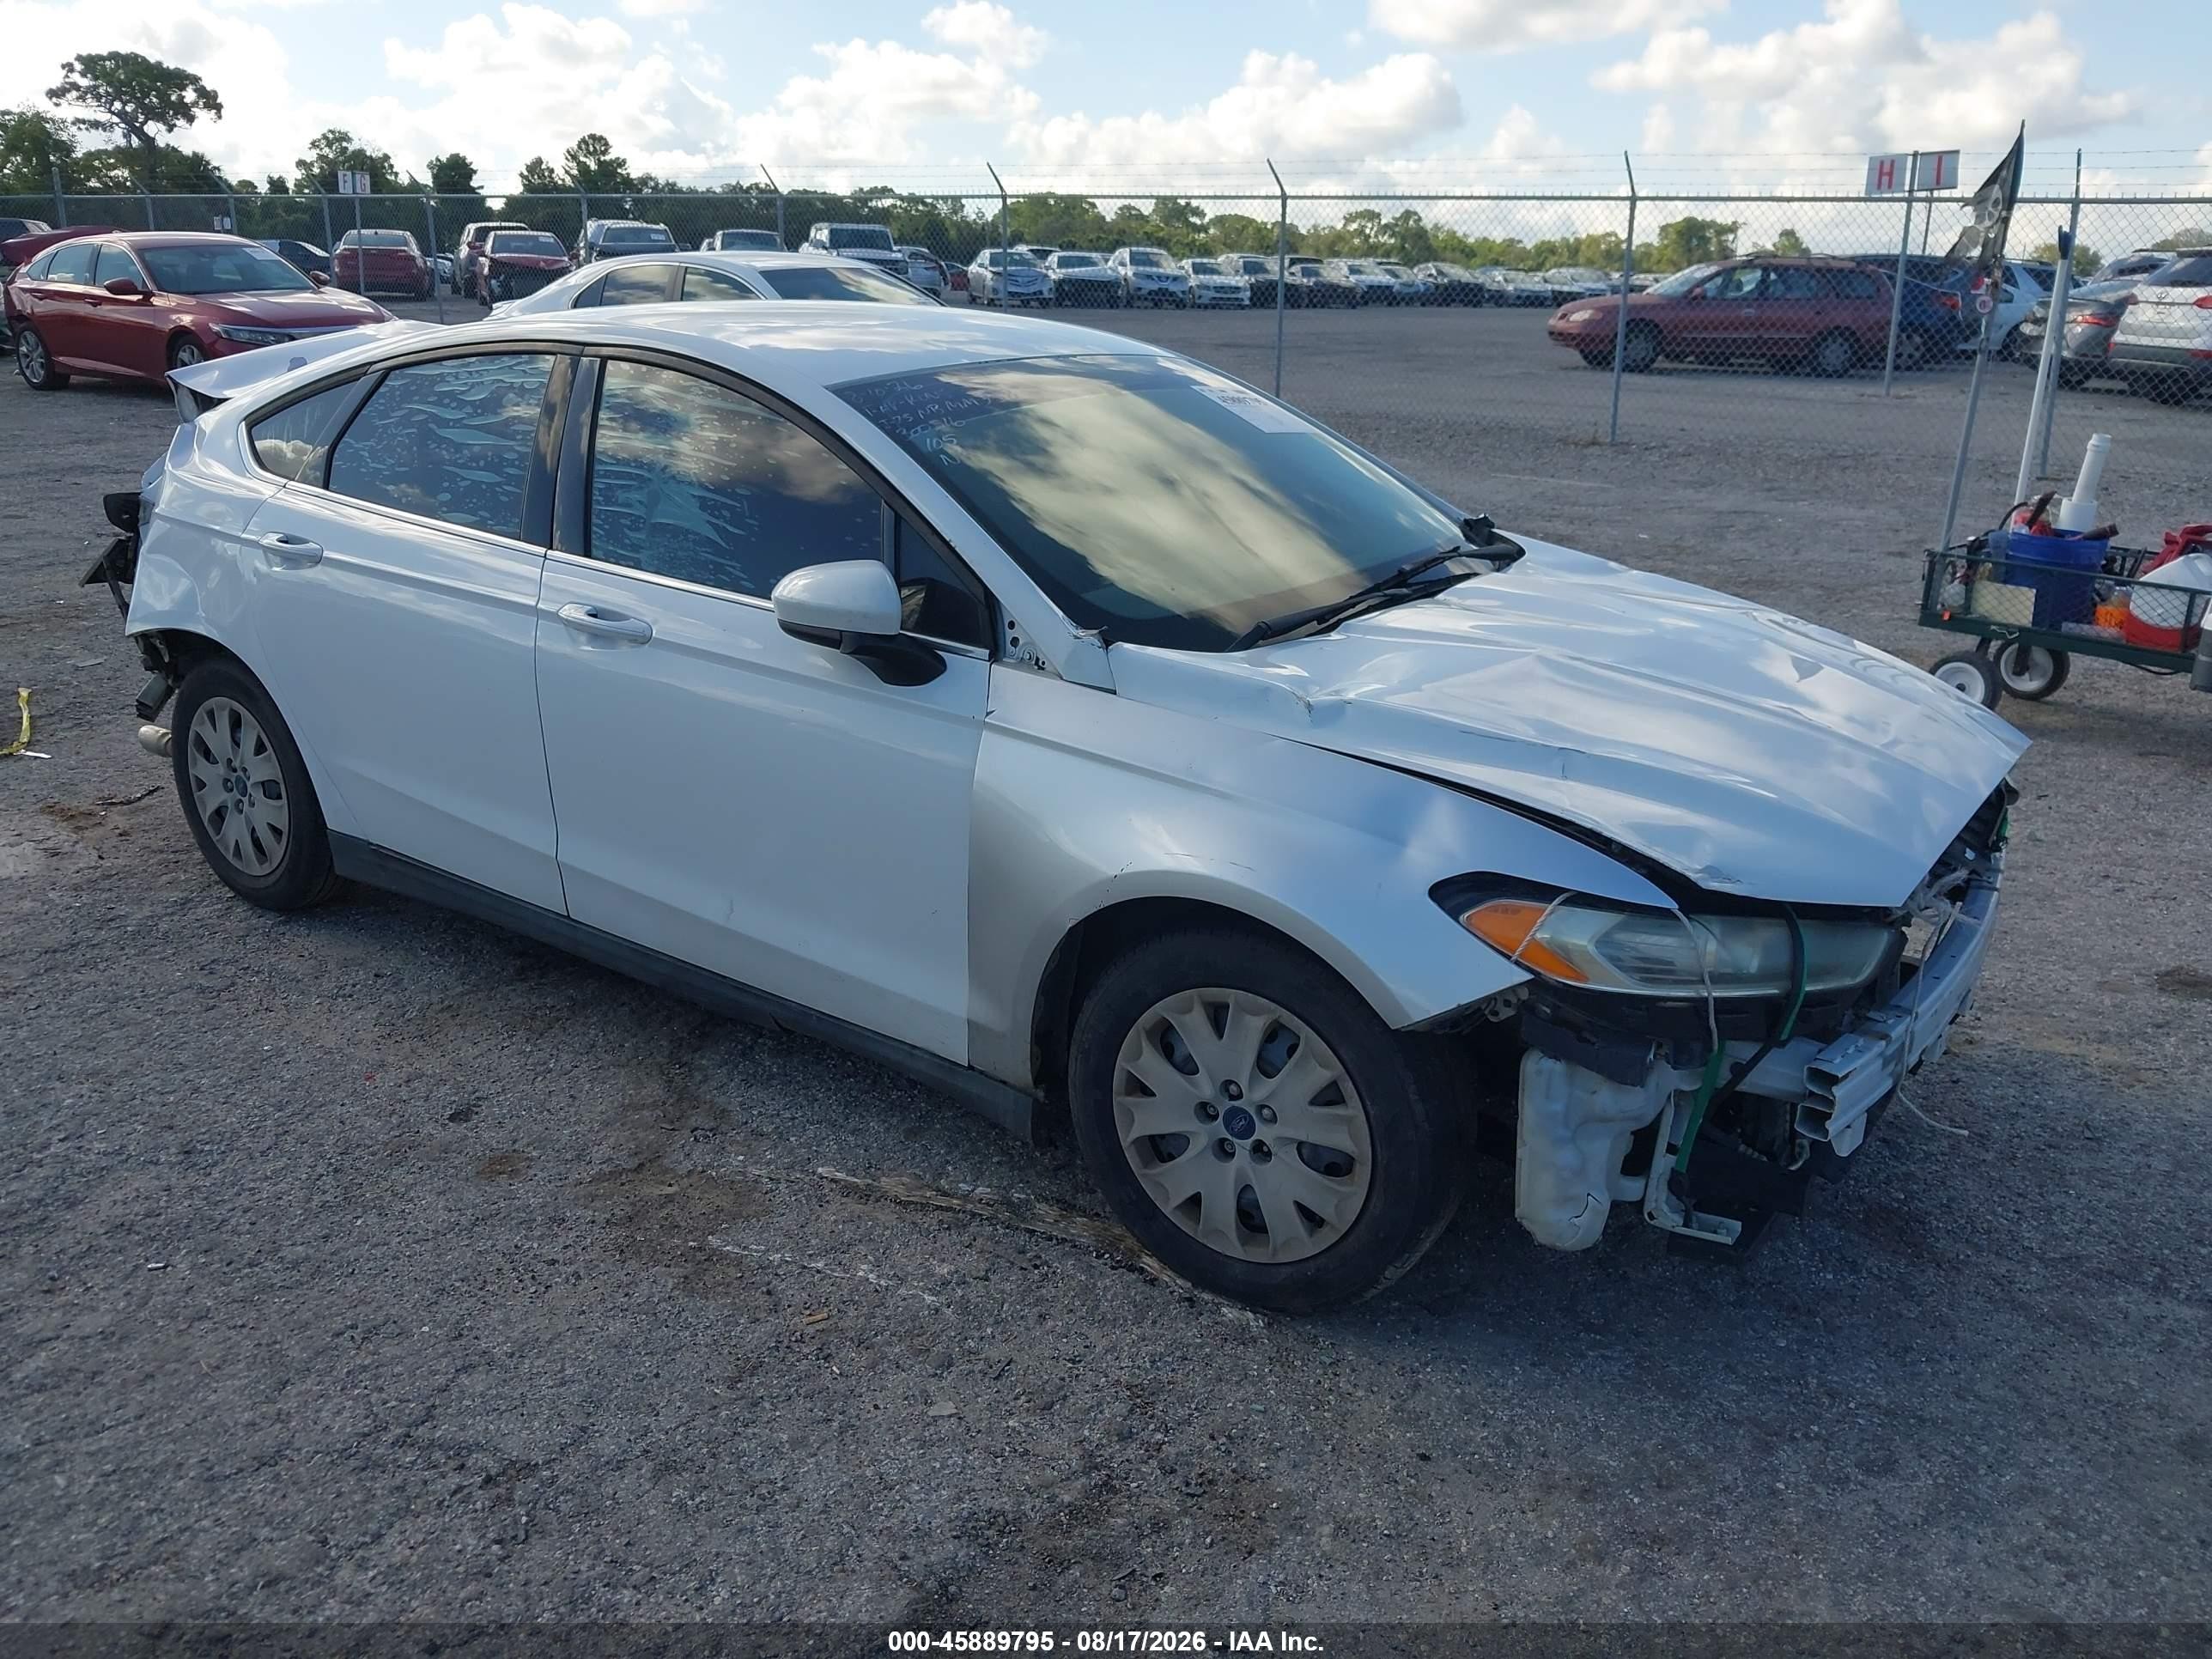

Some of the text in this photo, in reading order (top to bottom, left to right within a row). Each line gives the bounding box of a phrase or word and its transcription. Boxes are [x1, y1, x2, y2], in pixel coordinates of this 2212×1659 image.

[361, 174, 367, 192] G
[1877, 159, 1895, 191] H
[1936, 155, 1943, 186] I
